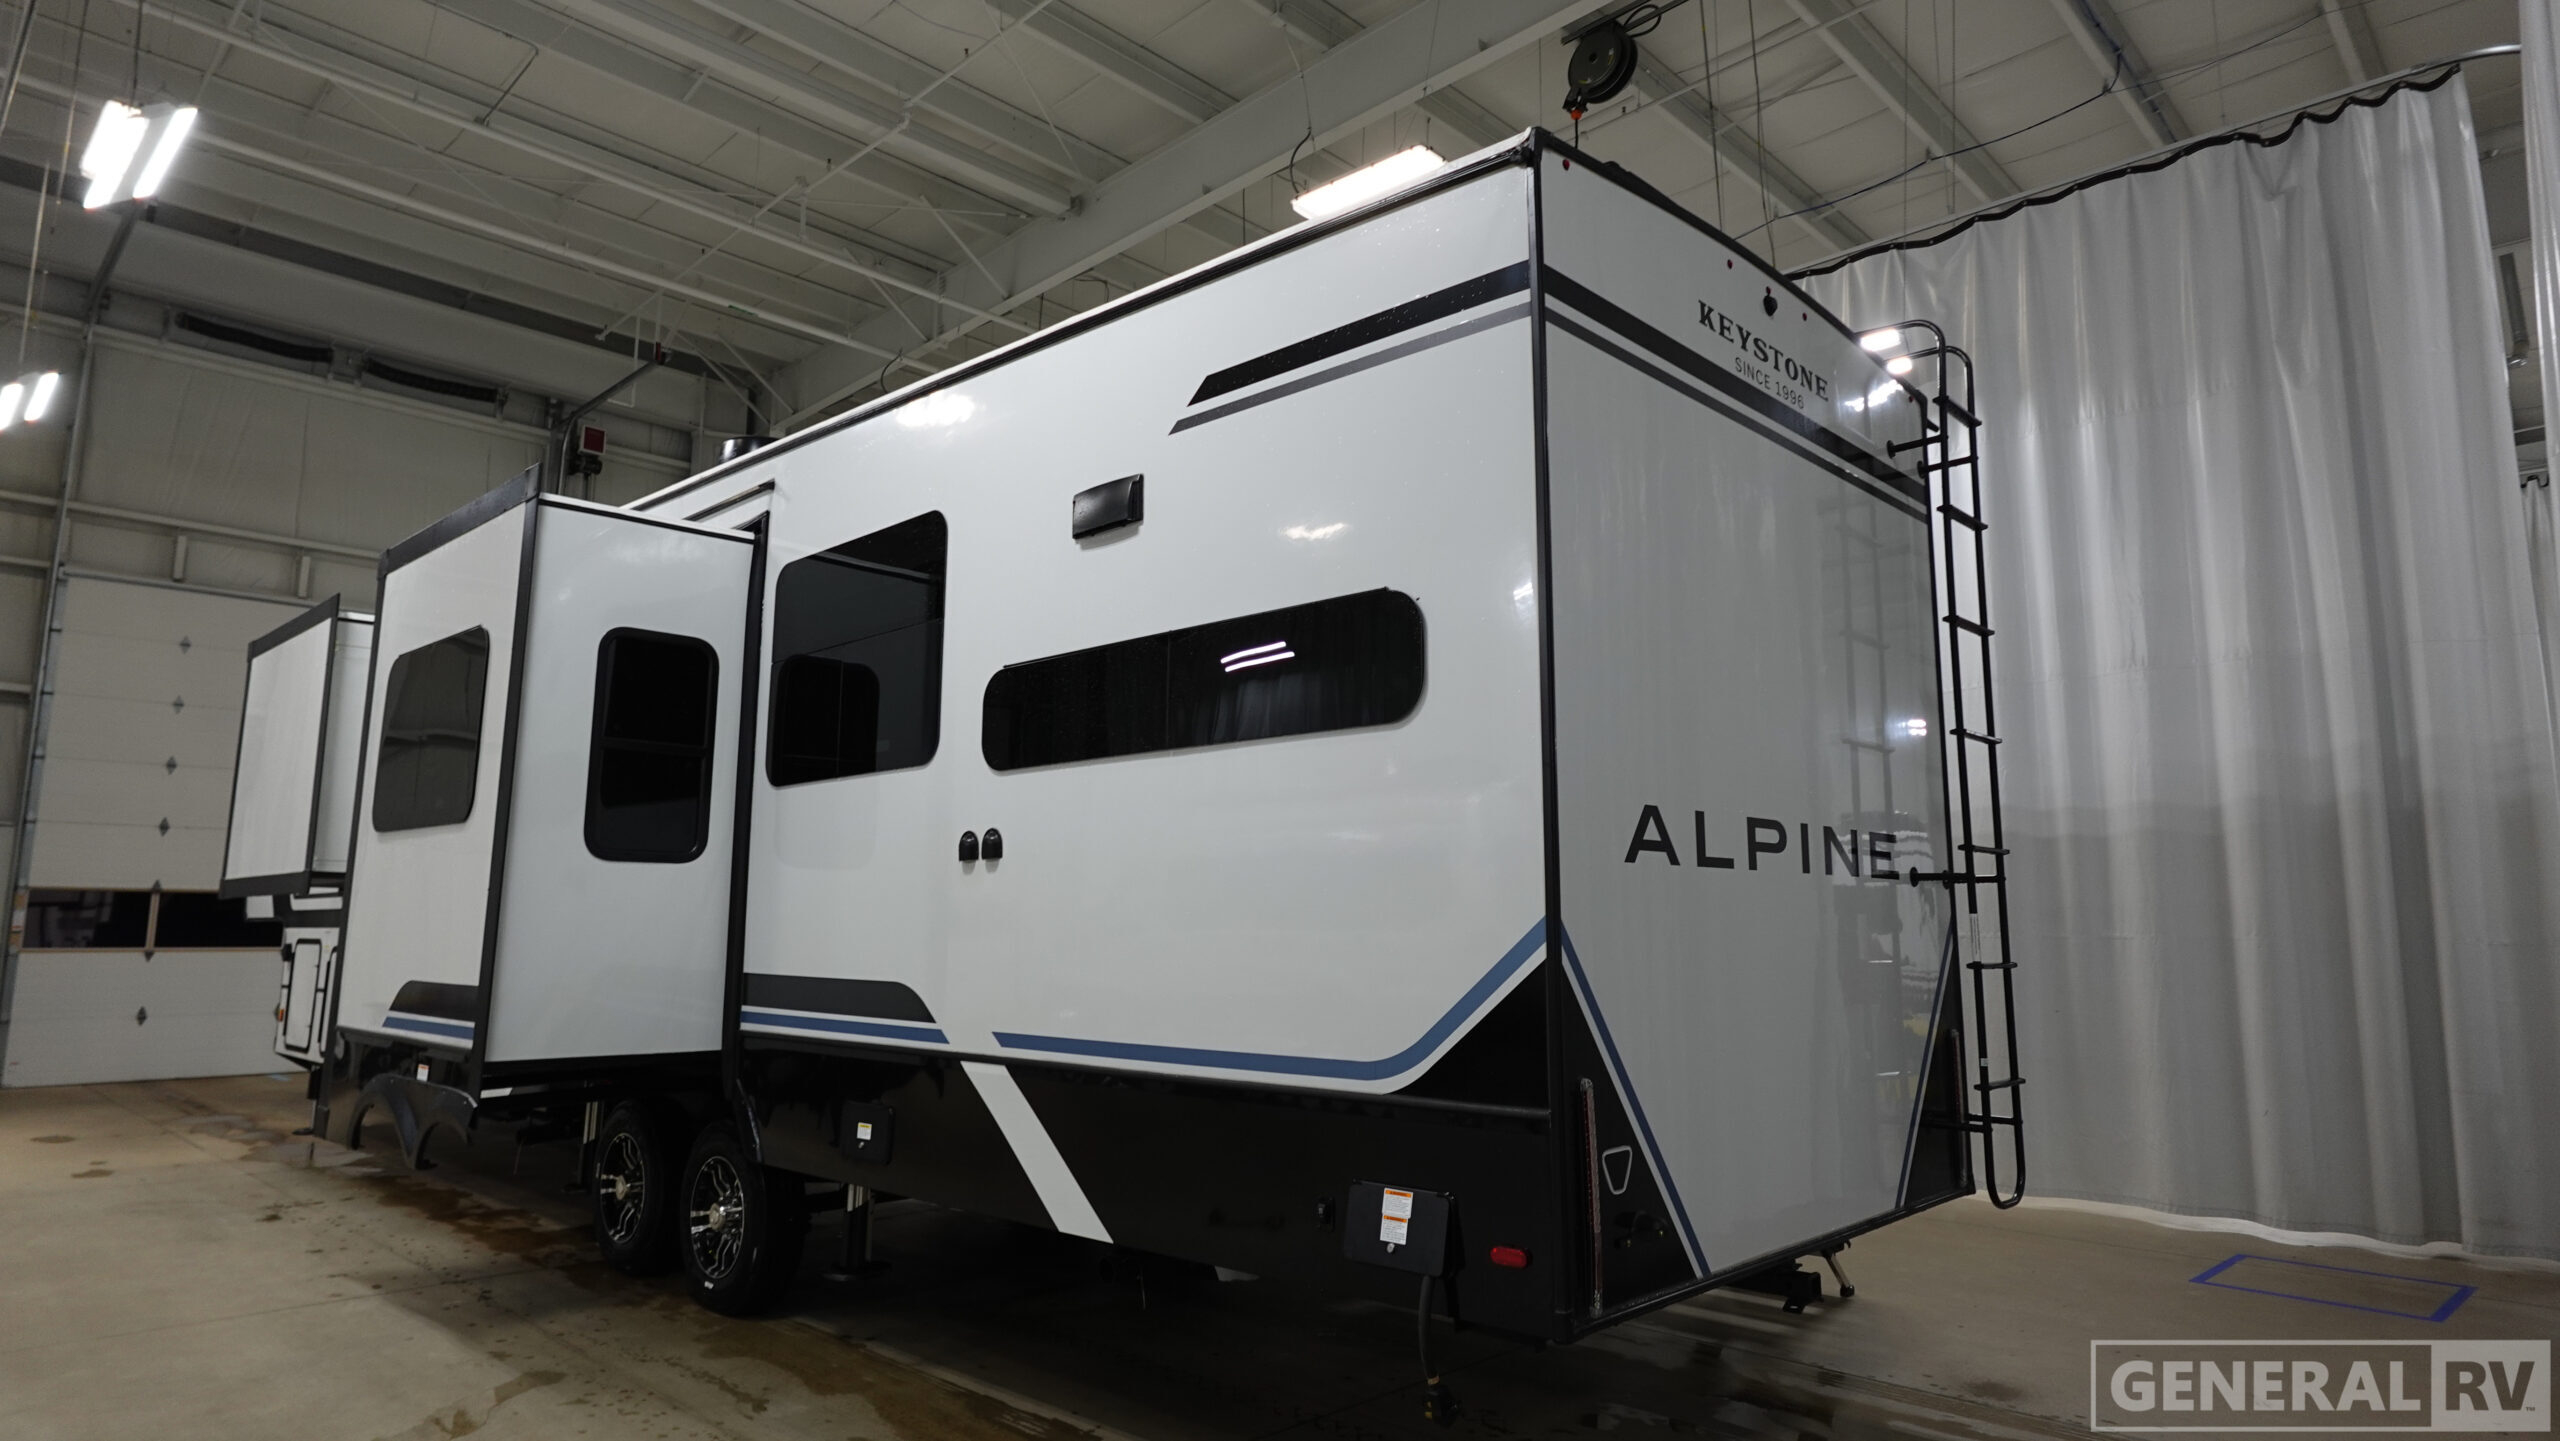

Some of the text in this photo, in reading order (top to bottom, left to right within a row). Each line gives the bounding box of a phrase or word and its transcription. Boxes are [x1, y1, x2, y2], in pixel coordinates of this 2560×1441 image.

[1698, 299, 1829, 402] KEYSTONE
[1735, 357, 1804, 409] SINCE 1996
[1624, 804, 1900, 880] ALPINE
